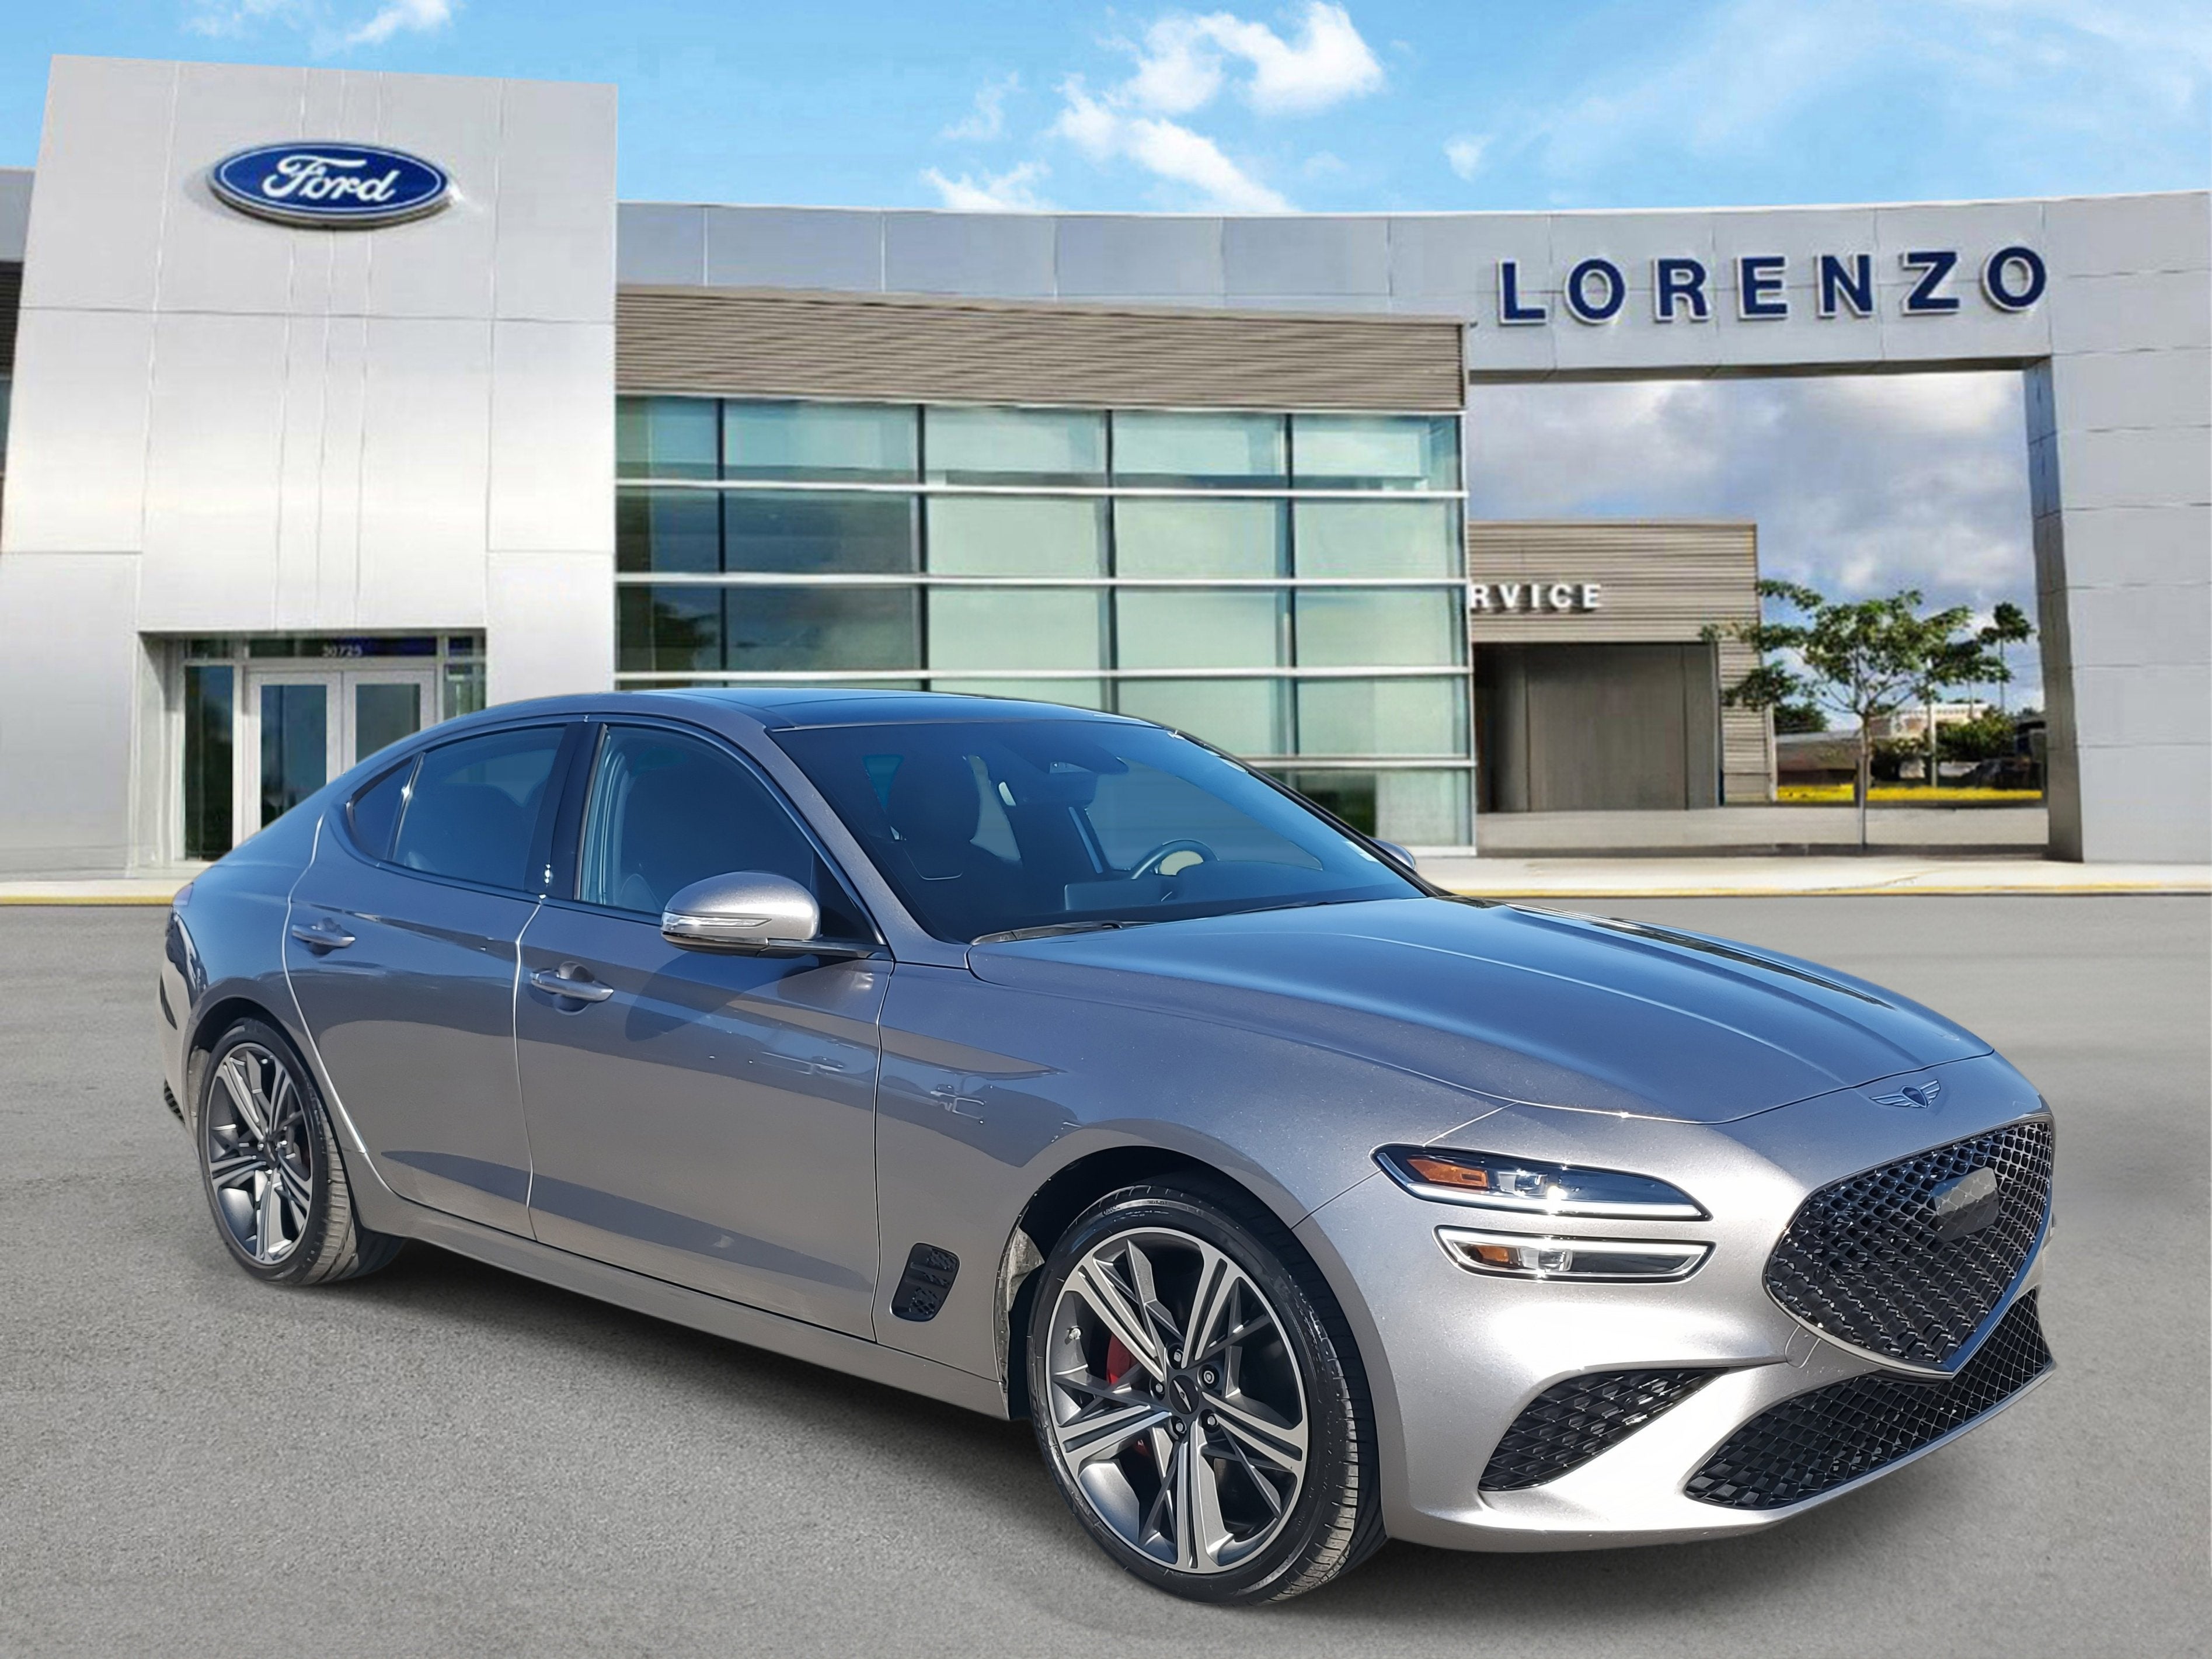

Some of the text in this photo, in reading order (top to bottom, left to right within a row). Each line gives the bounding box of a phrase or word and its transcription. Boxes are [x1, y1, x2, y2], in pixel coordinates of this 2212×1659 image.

[262, 154, 400, 202] Ford
[1497, 246, 2047, 325] LORENZO
[1470, 583, 1602, 608] RVICE
